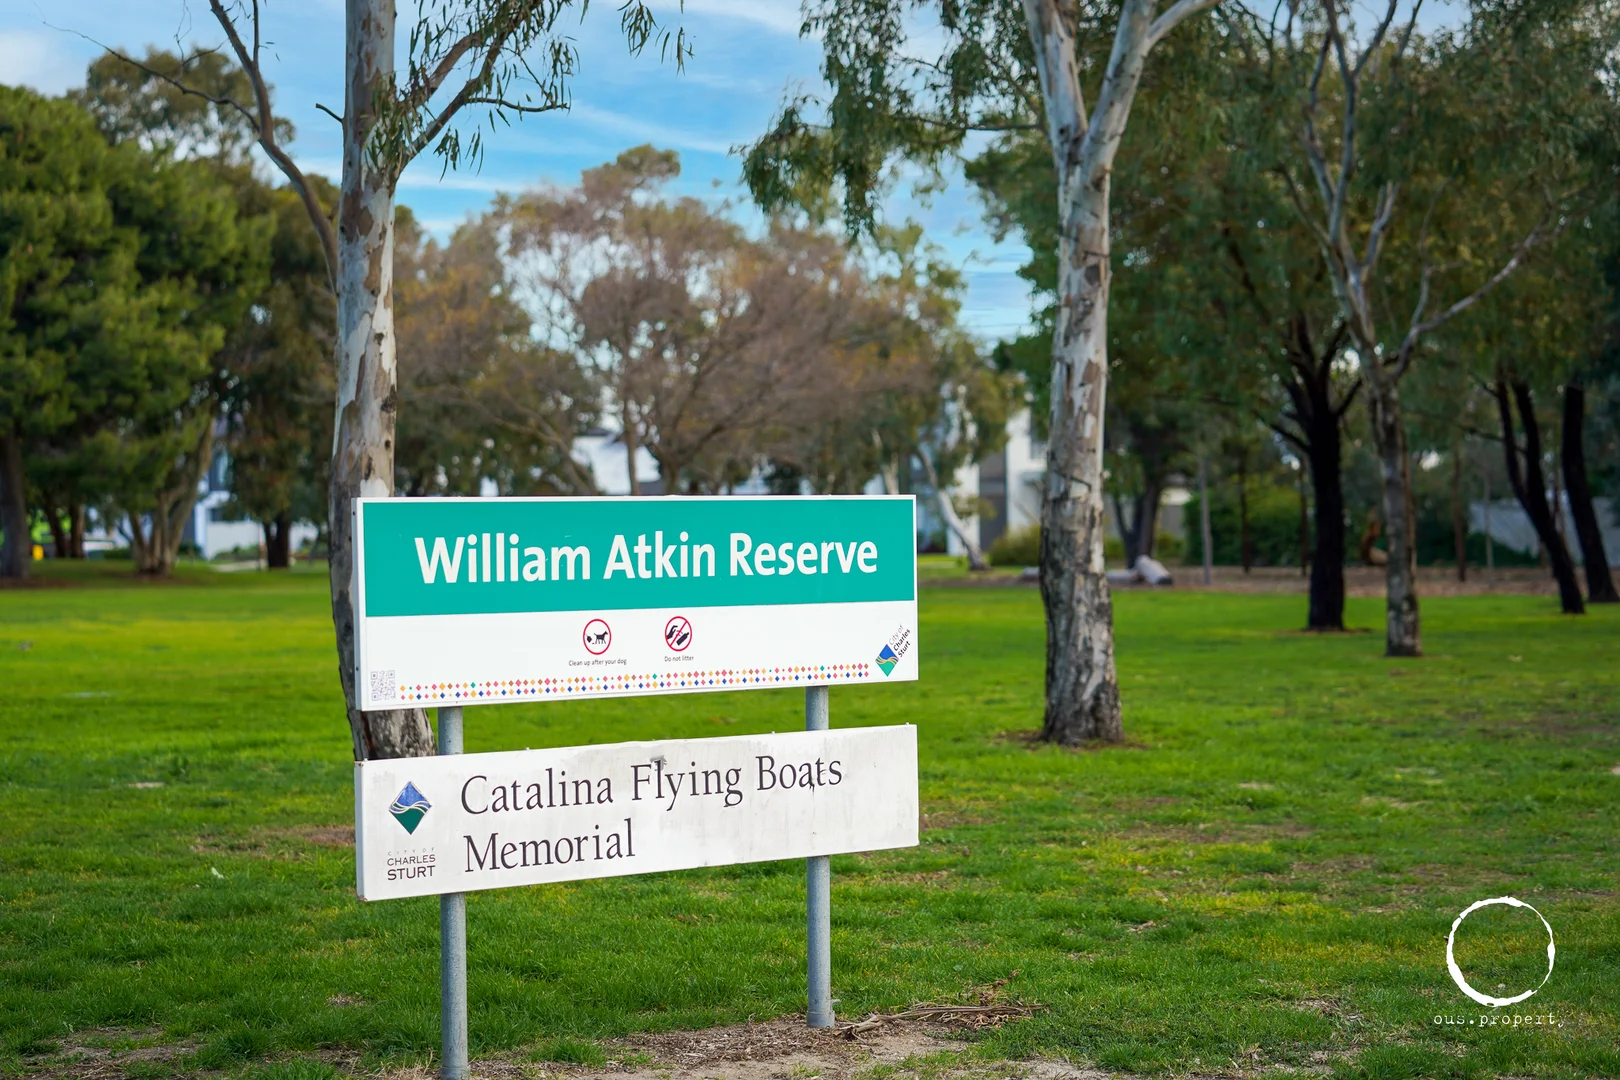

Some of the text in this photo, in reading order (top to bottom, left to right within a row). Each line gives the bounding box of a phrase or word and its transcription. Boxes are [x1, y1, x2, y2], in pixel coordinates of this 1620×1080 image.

[415, 530, 878, 584] William Atkin Reserve
[893, 628, 910, 652] Charles
[898, 640, 910, 658] Sturt
[604, 659, 616, 667] your
[461, 755, 842, 815] Catalina Flying Boats
[388, 848, 416, 856] CITY
[463, 818, 636, 873] Memorial
[387, 854, 436, 866] CHARLES
[387, 865, 436, 880] STURT
